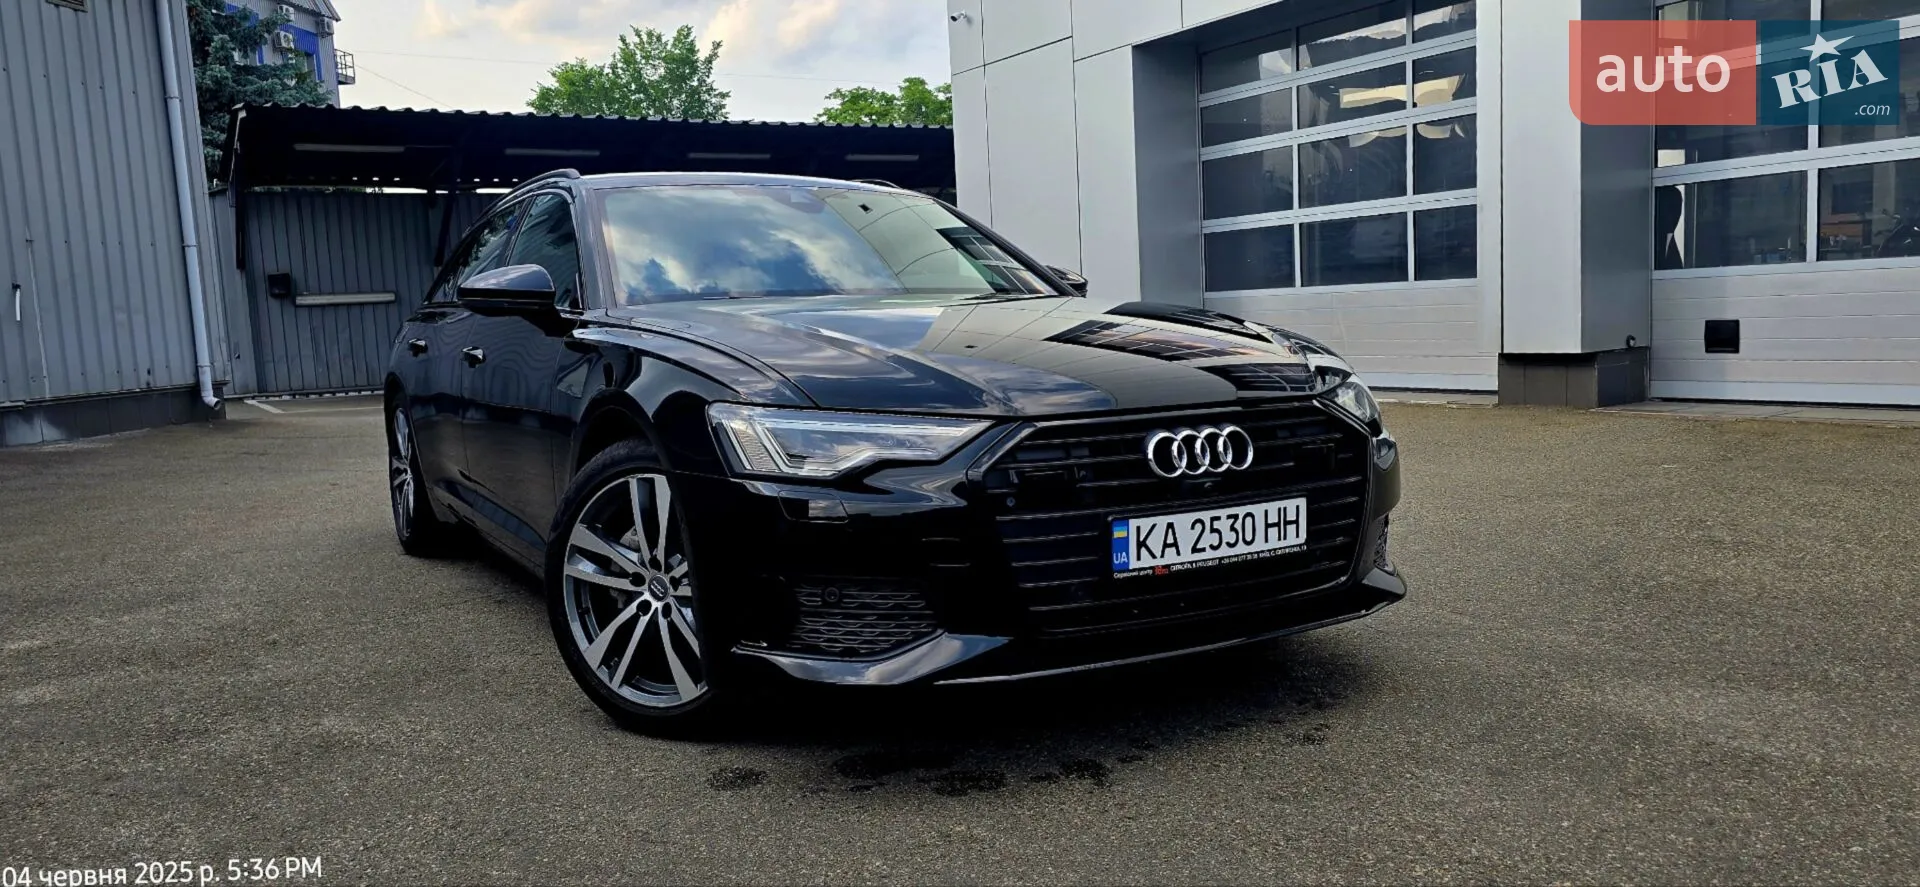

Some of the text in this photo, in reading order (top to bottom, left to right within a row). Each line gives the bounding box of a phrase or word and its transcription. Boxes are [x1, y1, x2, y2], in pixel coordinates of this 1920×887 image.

[1136, 504, 1300, 562] KA 2530 HH
[1113, 552, 1128, 564] UA
